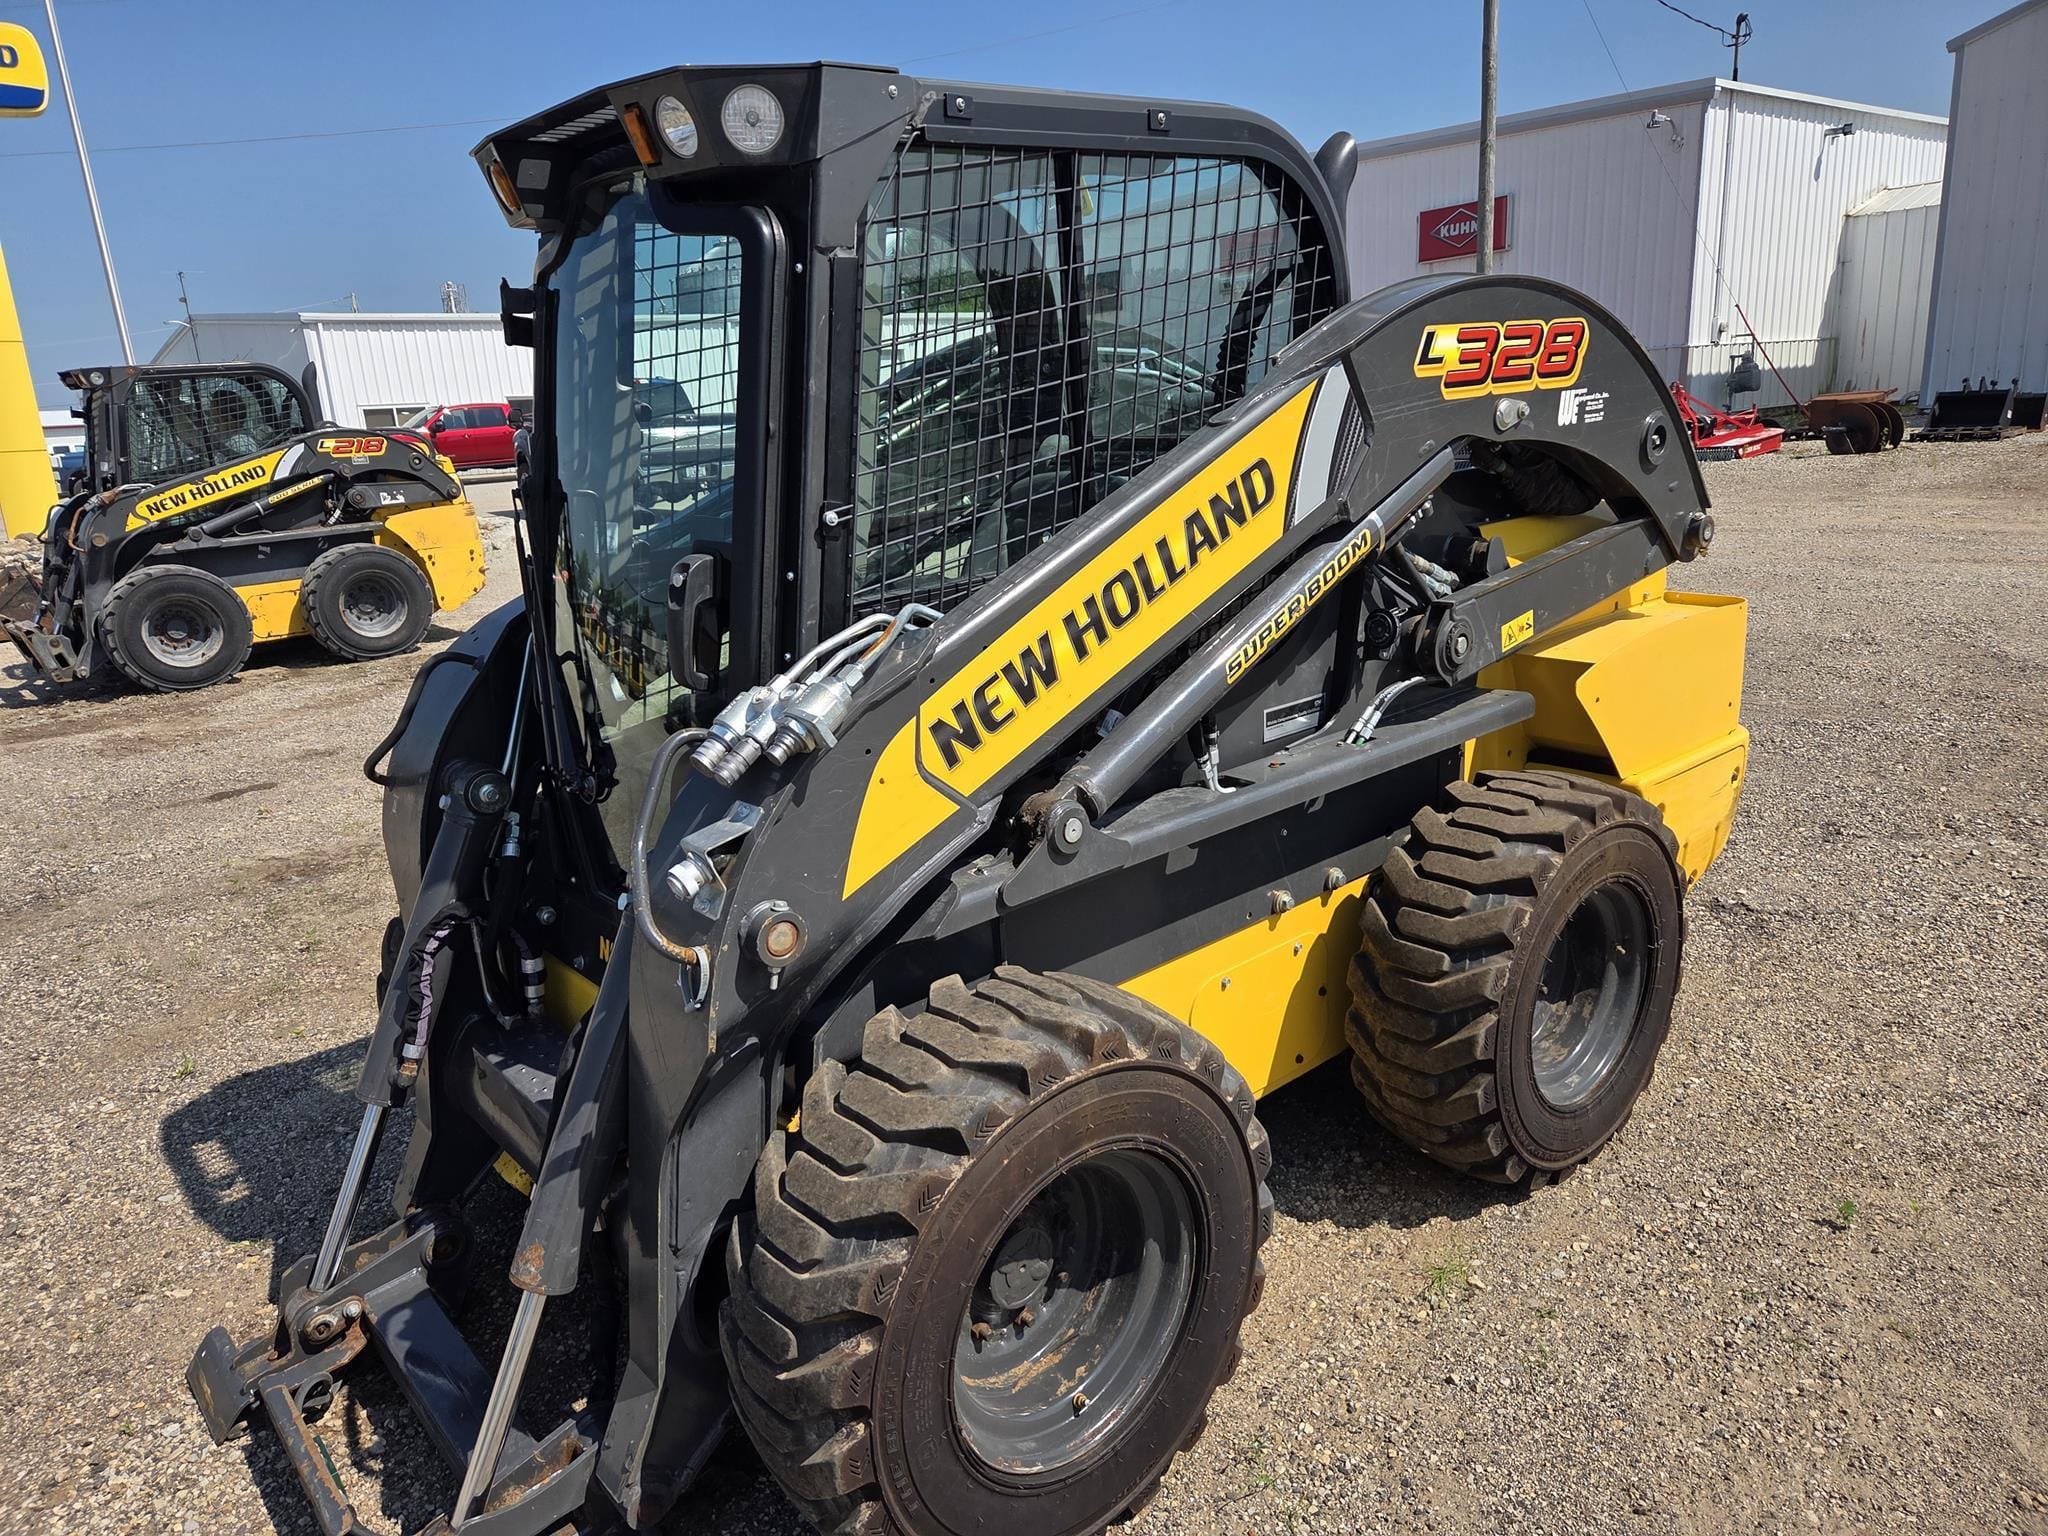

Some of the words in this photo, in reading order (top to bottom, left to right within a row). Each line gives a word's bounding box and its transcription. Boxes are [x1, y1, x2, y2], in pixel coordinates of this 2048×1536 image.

[1415, 318, 1589, 398] L328
[317, 437, 387, 457] L218
[145, 490, 187, 516] NEW
[188, 465, 267, 501] HOLLAND
[928, 629, 1060, 772] NEW
[1061, 456, 1275, 664] HOLLAND
[1227, 594, 1306, 684] SUPER
[1304, 528, 1372, 607] BOOM
